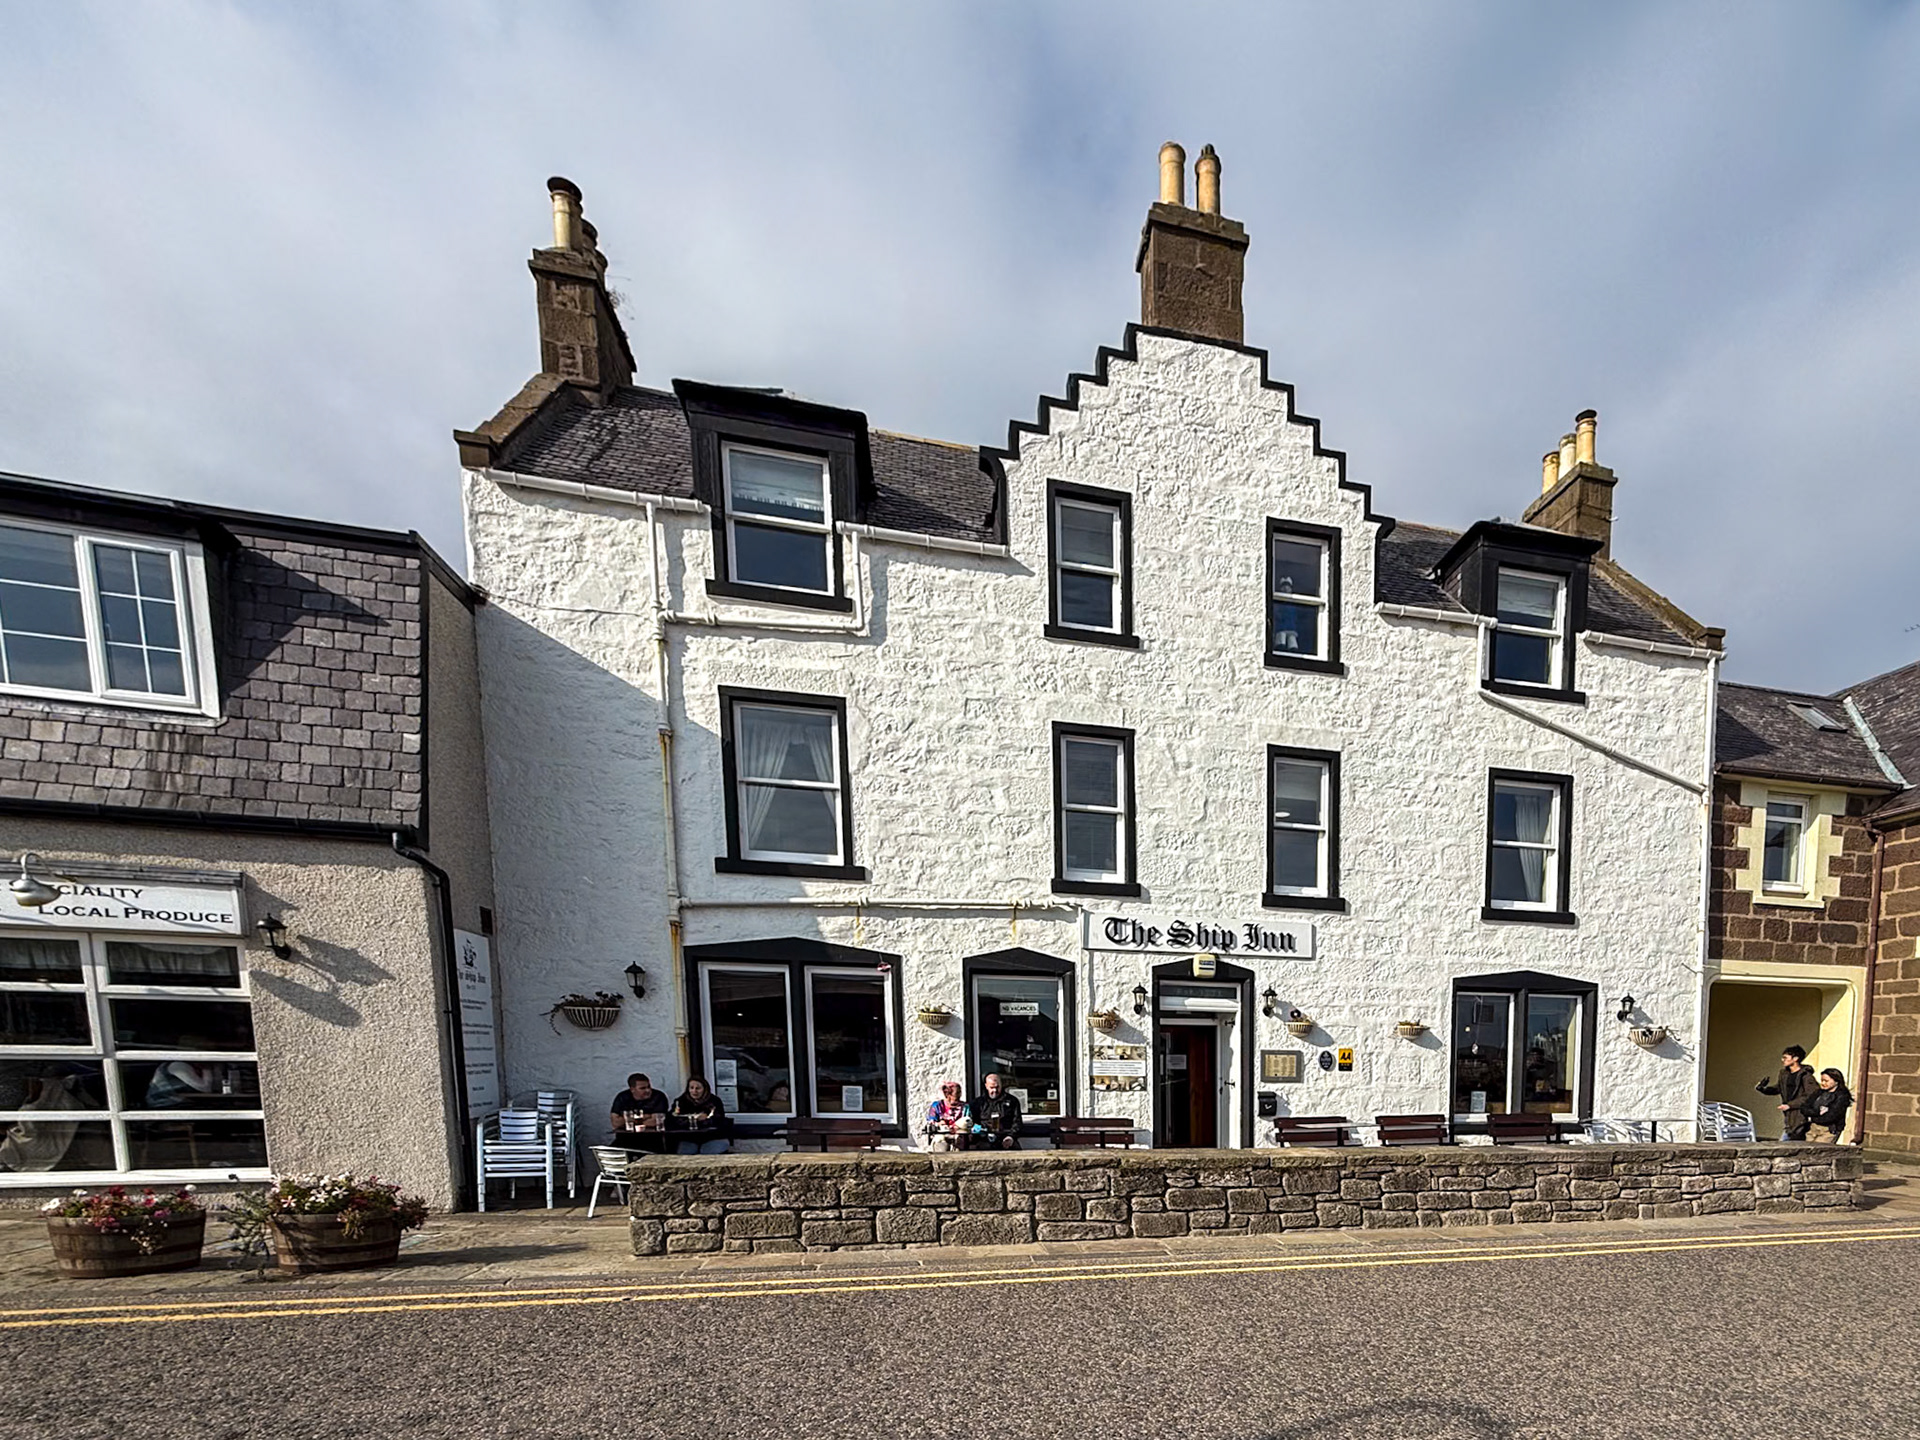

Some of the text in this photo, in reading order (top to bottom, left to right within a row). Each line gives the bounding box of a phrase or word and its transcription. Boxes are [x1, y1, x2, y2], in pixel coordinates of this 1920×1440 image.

[38, 905, 234, 924] LOCAL PRODUCE
[1102, 917, 1297, 954] The Ship Inn
[1341, 1052, 1351, 1060] AA
